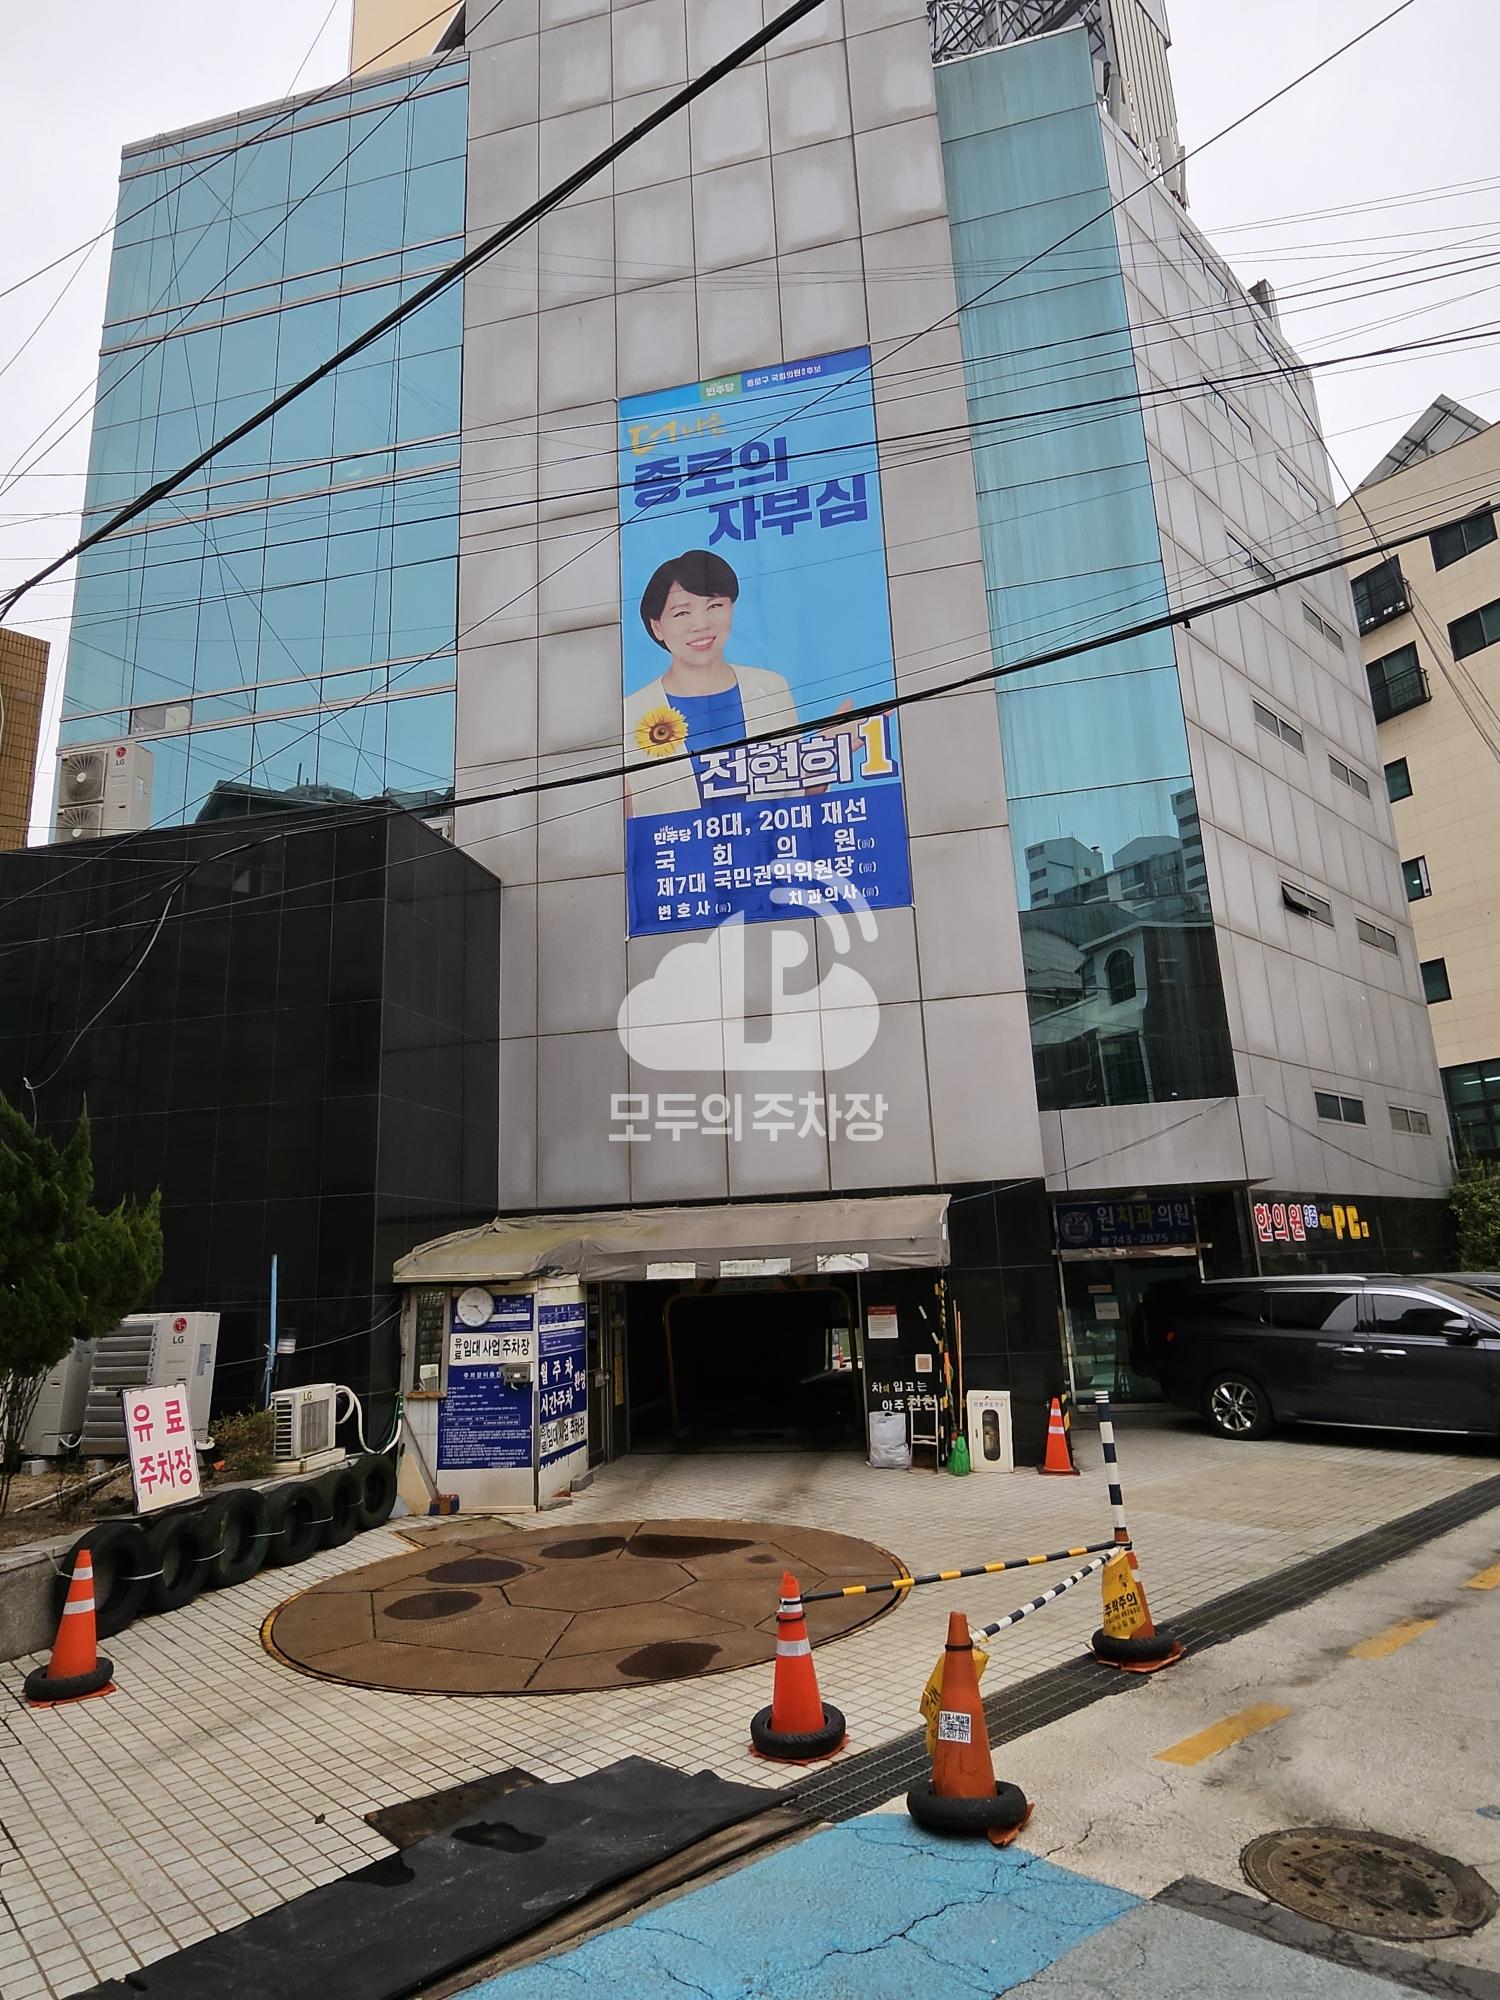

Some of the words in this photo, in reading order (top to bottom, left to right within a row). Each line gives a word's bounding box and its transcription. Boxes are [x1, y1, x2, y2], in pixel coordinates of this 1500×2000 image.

[706, 382, 735, 397] 민주당
[747, 376, 769, 388] 종로구
[771, 368, 800, 382] 국회의원
[806, 365, 821, 375] 후보
[633, 436, 788, 509] 종로의
[708, 473, 868, 546] 자부심
[700, 734, 853, 801] 전현희
[858, 714, 896, 779] 1
[653, 828, 691, 846] 민주당
[692, 812, 751, 838] 18대,
[759, 804, 812, 832] 20대
[821, 797, 868, 825] 재선
[657, 873, 707, 897] 제7대
[714, 855, 855, 890] 국민권익위원장
[1254, 1203, 1306, 1242] 한의원
[172, 1335, 184, 1345] LG
[463, 1339, 480, 1357] 임대
[483, 1339, 500, 1357] 사업
[503, 1338, 530, 1356] 주차장
[303, 1391, 312, 1401] LG
[540, 1386, 573, 1417] 시간주차
[893, 1380, 927, 1393] 입고는
[882, 1399, 904, 1412] 아주
[133, 1400, 186, 1443] 유료
[570, 1416, 585, 1441] 주차장
[139, 1446, 192, 1495] 주차장
